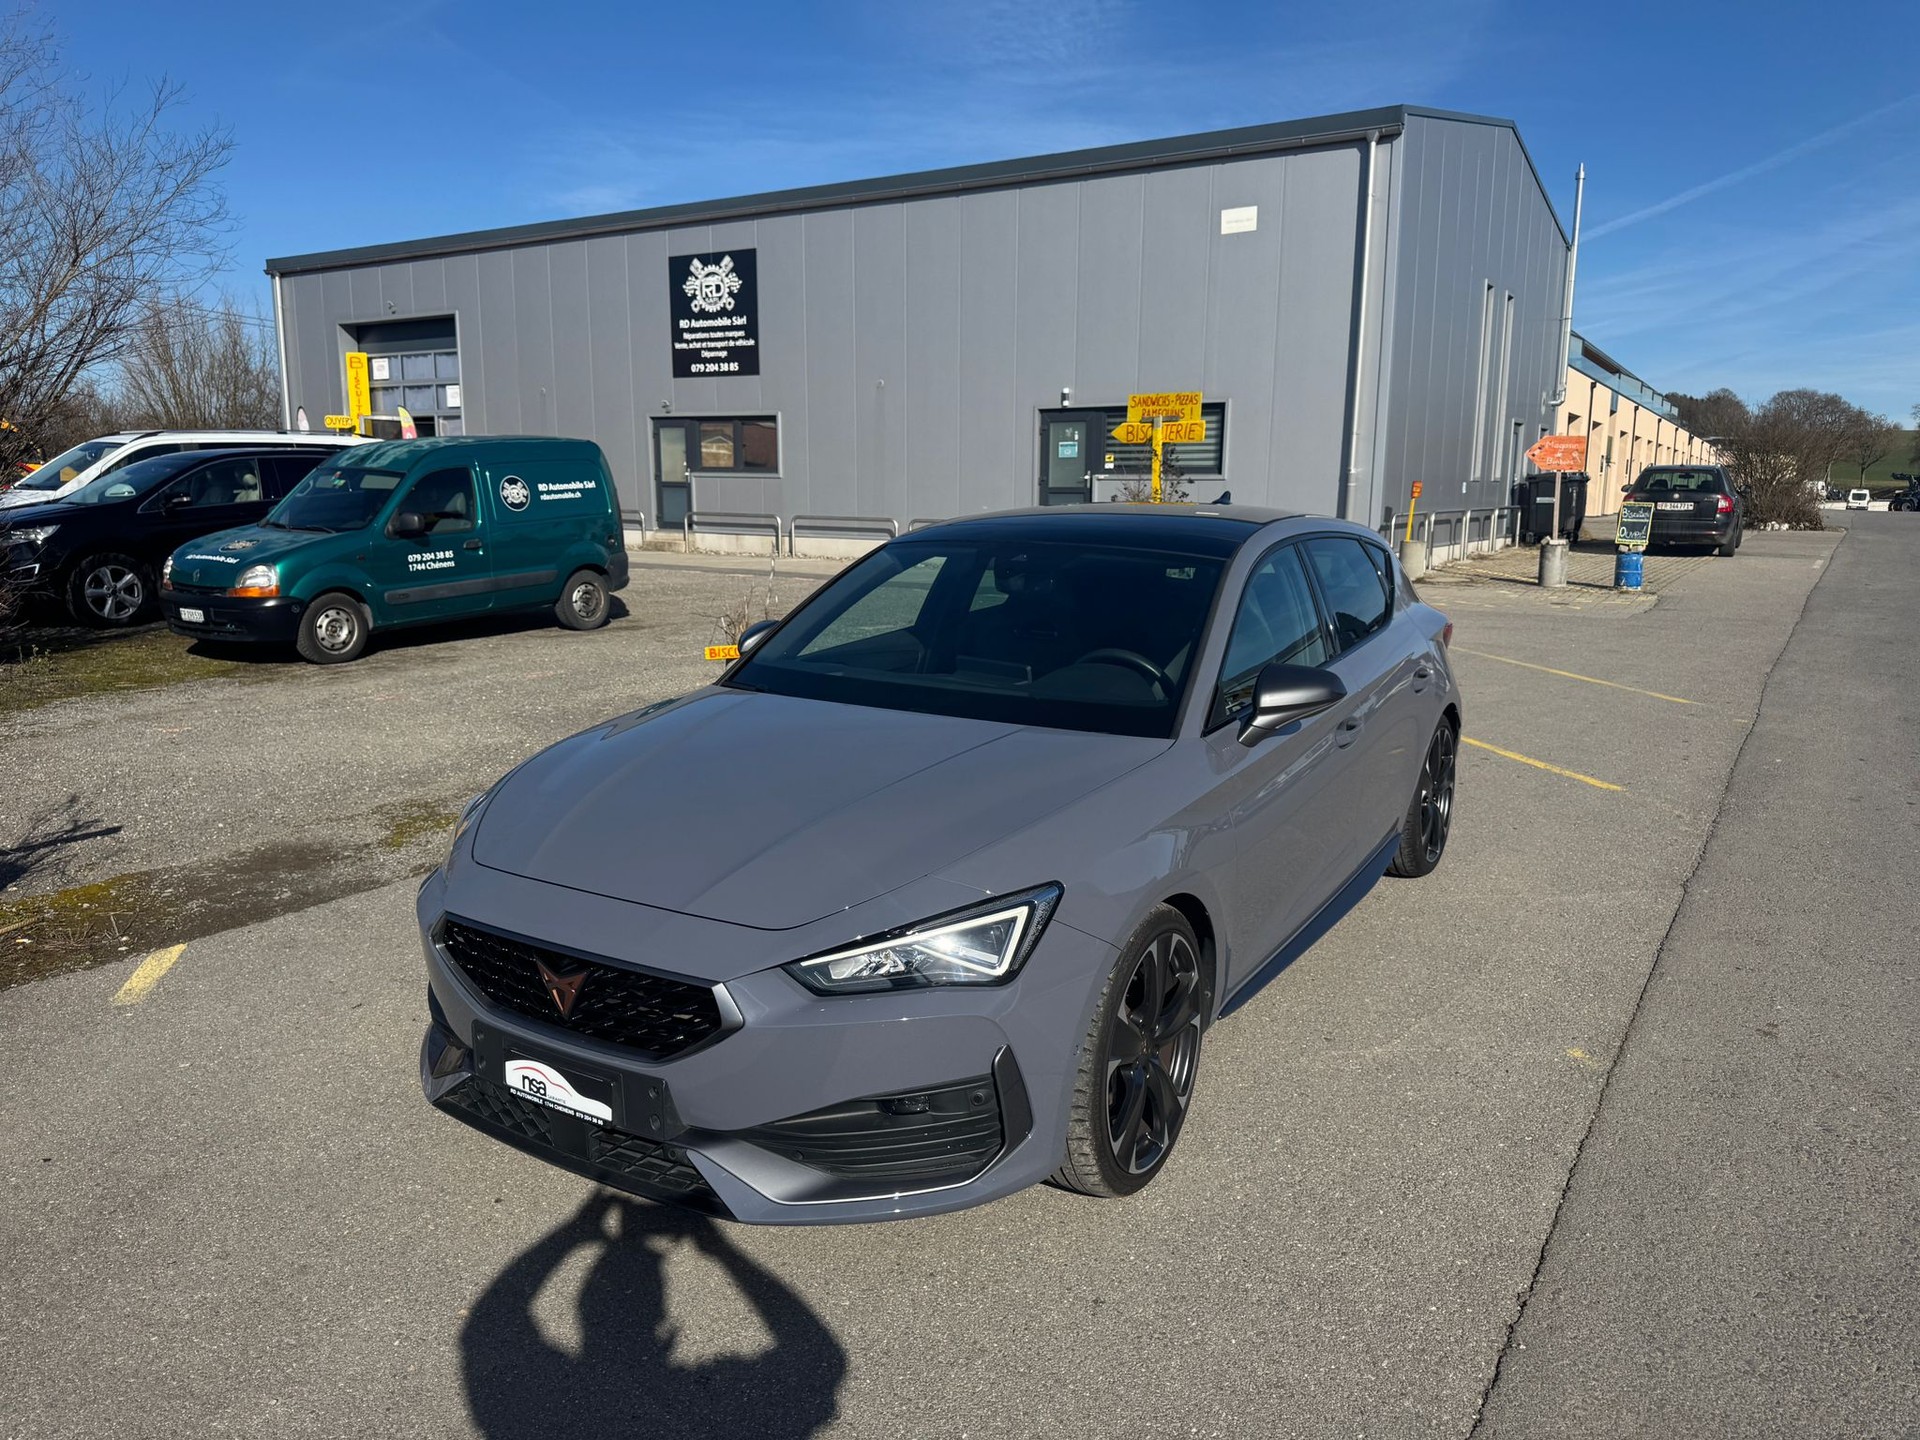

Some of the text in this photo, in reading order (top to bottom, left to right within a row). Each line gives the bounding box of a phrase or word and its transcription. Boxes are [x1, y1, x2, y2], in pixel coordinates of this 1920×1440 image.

[679, 319, 690, 329] RD
[690, 317, 732, 328] Automobile
[691, 362, 739, 373] 079 204 38 85
[1126, 422, 1198, 442] BISCTERIE
[538, 483, 548, 492] RD
[548, 481, 584, 491] Automobile
[540, 491, 582, 501] rdautomobile.ch
[408, 550, 454, 562] 079 204 38 85
[408, 560, 455, 571] 1744 Chénens
[522, 1074, 547, 1097] nsa
[510, 1087, 517, 1095] RD
[516, 1090, 544, 1105] AUTOMOBILE
[544, 1100, 554, 1109] 1744
